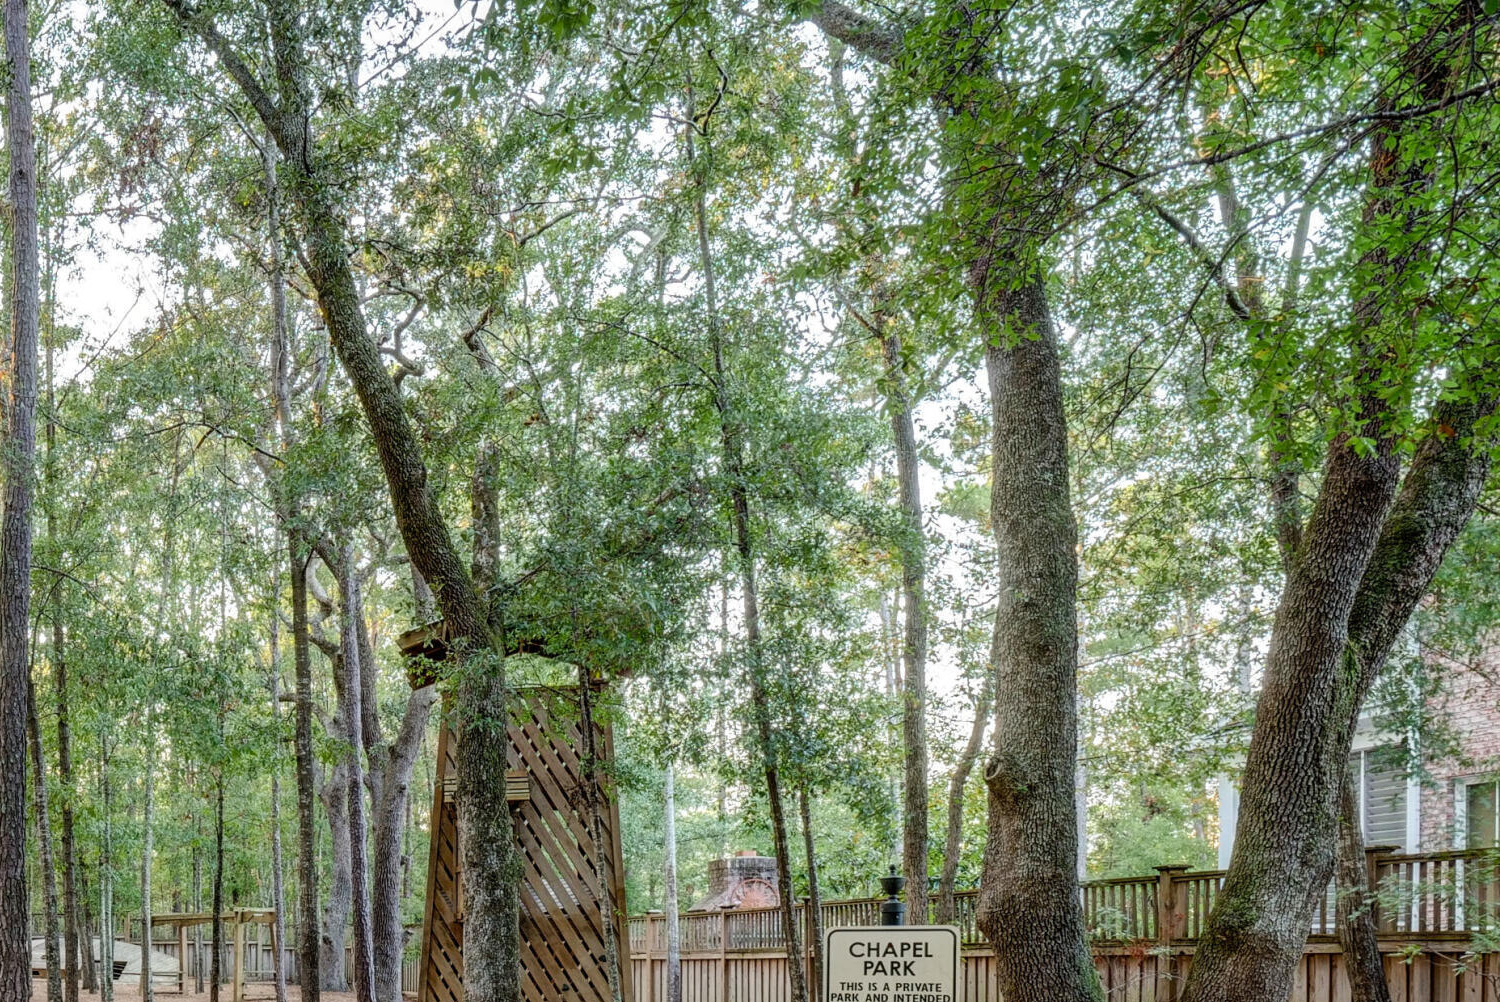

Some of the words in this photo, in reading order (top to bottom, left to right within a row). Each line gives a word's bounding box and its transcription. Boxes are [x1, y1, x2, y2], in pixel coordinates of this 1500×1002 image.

[849, 942, 933, 957] CHAPEL
[864, 961, 915, 976] PARK
[840, 982, 863, 991] THIS
[869, 983, 877, 991] IS
[883, 983, 890, 991] A
[896, 983, 941, 992] PRIVATE
[831, 993, 859, 1002] PARK
[866, 994, 888, 1002] AND
